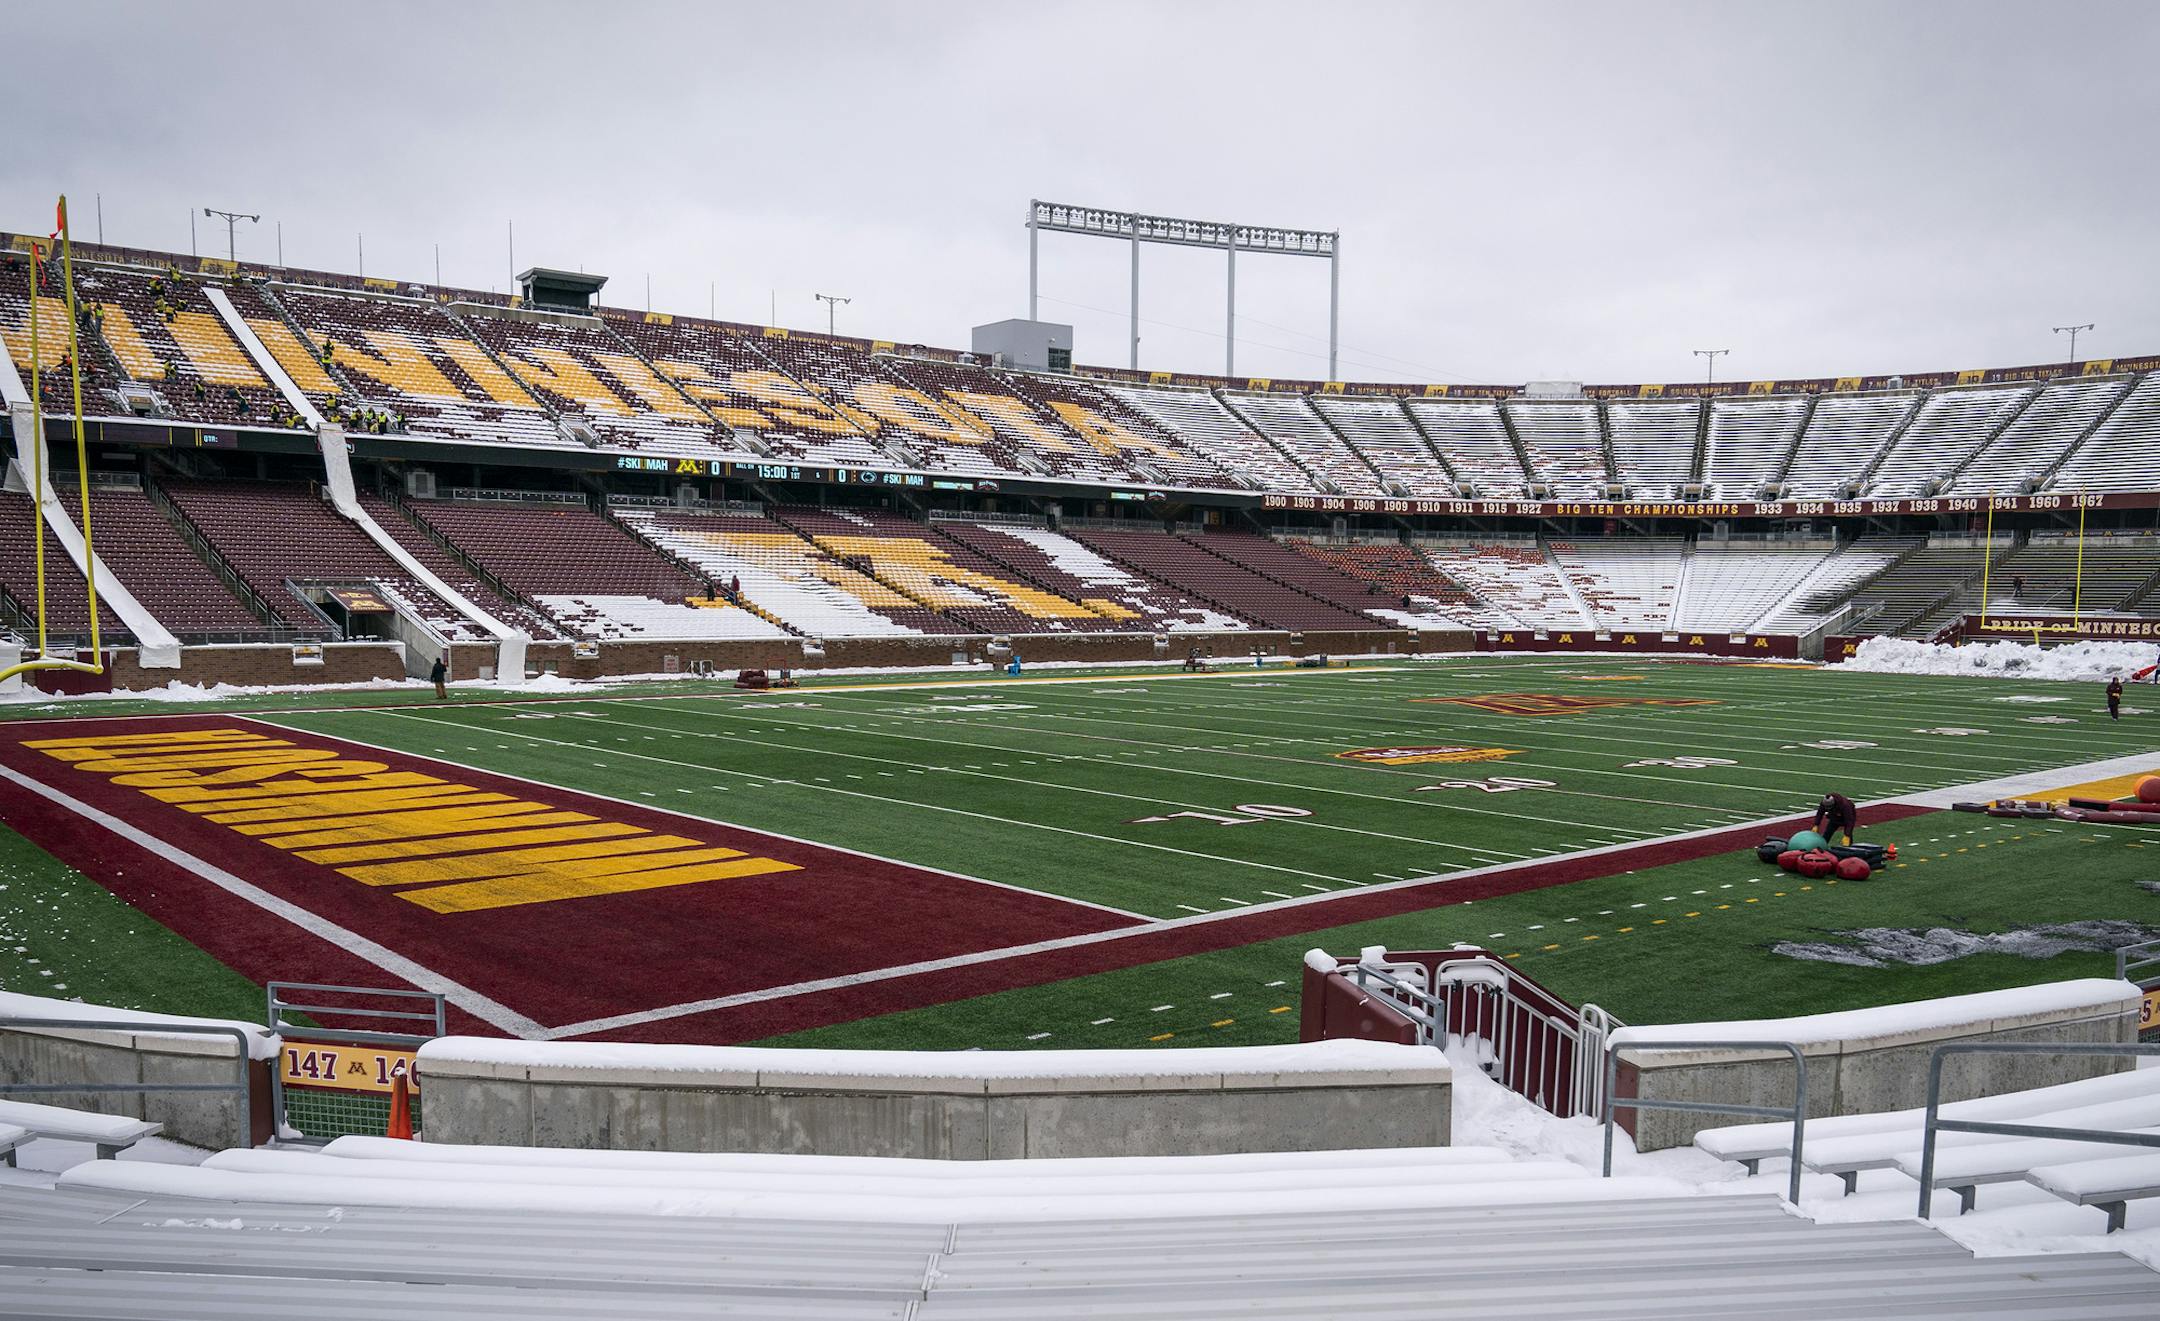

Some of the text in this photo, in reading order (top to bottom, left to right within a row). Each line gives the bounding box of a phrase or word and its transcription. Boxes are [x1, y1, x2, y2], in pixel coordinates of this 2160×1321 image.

[617, 457, 720, 475] #SKIUMAH M 0
[757, 465, 788, 479] 15:00
[837, 470, 846, 483] 0
[882, 473, 923, 486] #SKIUMAH
[1265, 495, 1287, 507] 1900
[1294, 496, 1315, 509] 1903
[1322, 498, 1345, 510] 1904
[1384, 500, 1408, 512] 1909
[1416, 501, 1441, 513] 1910
[1449, 502, 1474, 514] 1911
[1482, 503, 1508, 514] 1915
[1516, 503, 1542, 514] 1927
[1557, 504, 1581, 514] BIG
[1589, 505, 1614, 515] TEN
[1624, 504, 1739, 515] CHAMPIONSHIPS
[1754, 503, 1783, 515] 1933
[1796, 502, 1825, 515] 1934
[1833, 501, 1862, 514] 1935
[1871, 500, 1900, 513] 1937
[1909, 499, 1939, 512] 1938
[1948, 498, 1978, 511] 1940
[1988, 497, 2018, 510] 1941
[2029, 496, 2061, 509] 1960
[2071, 494, 2105, 508] 1967
[1990, 620, 2044, 632] PRIDE
[1501, 633, 1515, 644] M
[1558, 633, 1574, 644] M
[1621, 634, 1638, 644] M
[1688, 635, 1705, 646] M
[1753, 637, 1769, 648] M
[1439, 776, 1558, 793] 20
[1166, 803, 1315, 826] 10
[18, 728, 806, 915] MINNESOTA
[287, 1048, 338, 1081] 147
